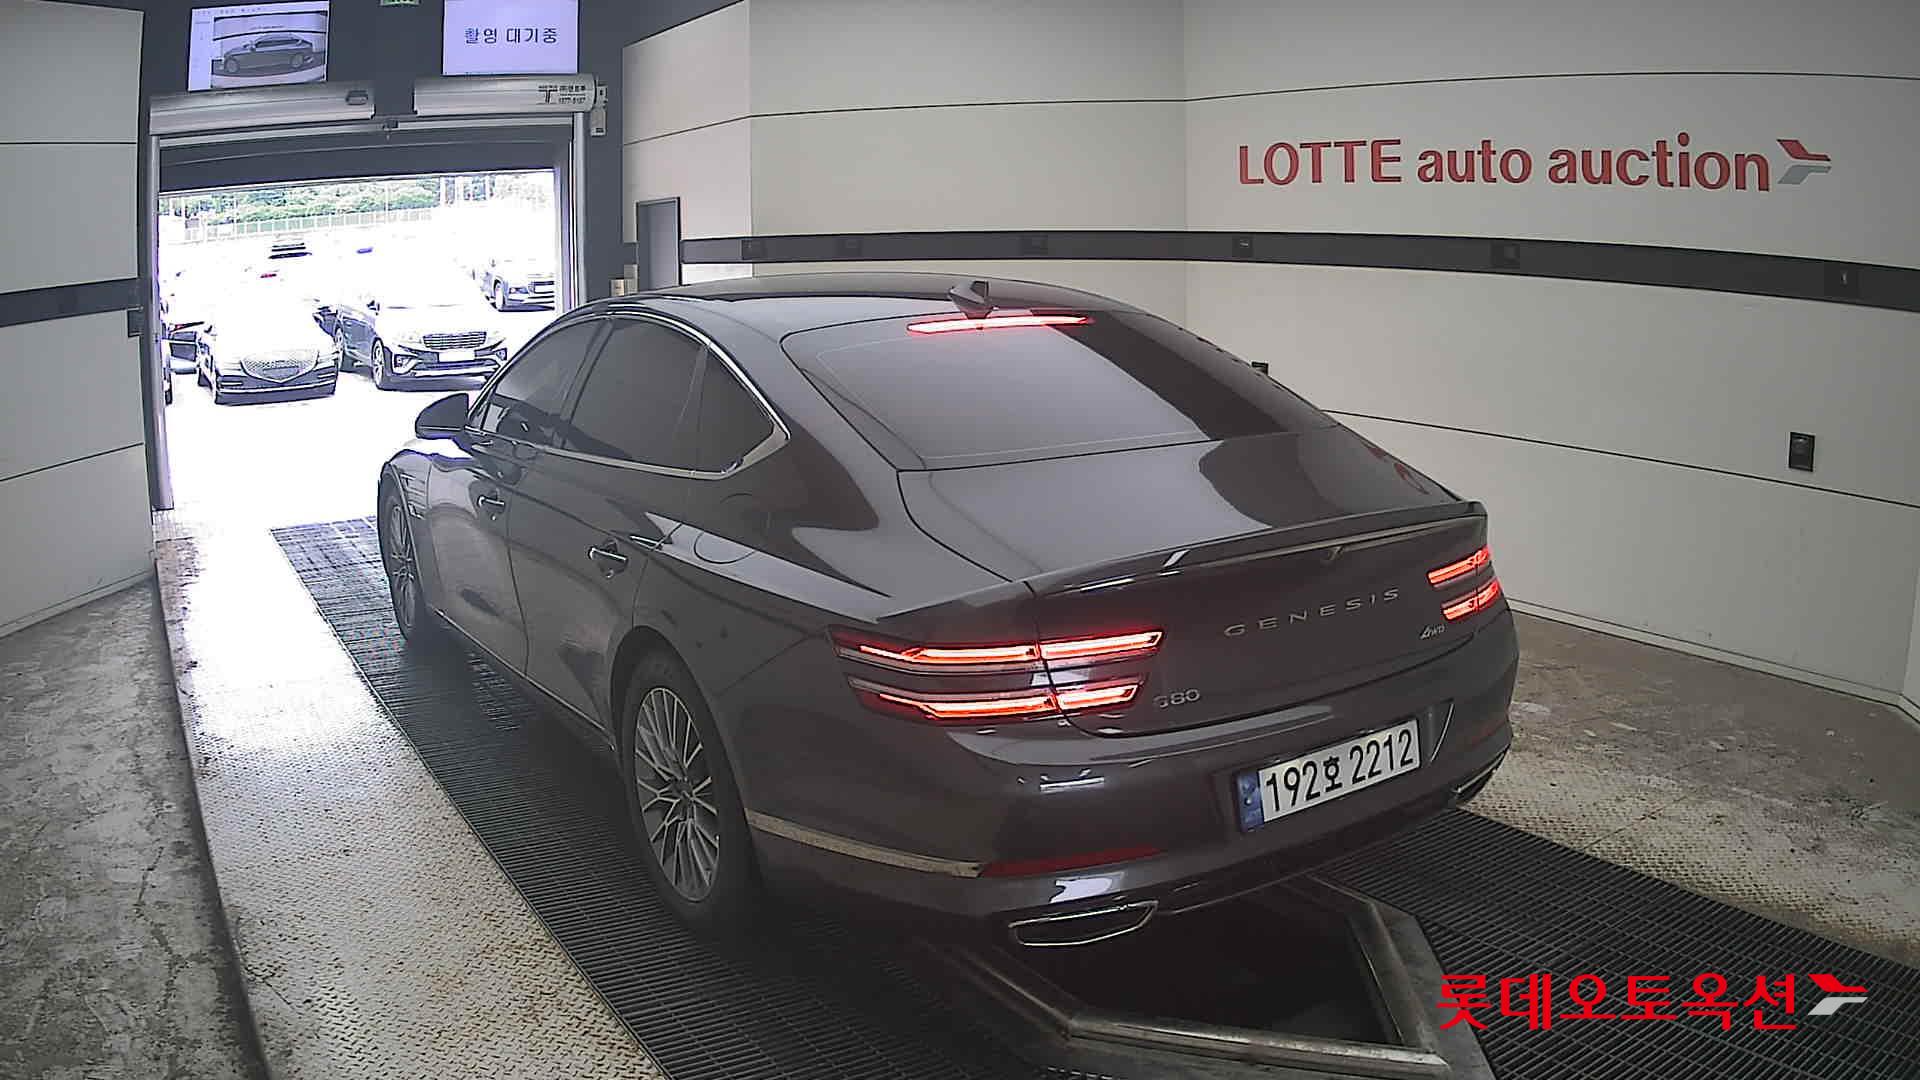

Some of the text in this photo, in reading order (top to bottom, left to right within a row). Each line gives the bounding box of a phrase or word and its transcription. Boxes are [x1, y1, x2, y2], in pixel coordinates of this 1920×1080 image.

[506, 27, 558, 44] 대기중
[1239, 132, 1770, 191] LOTTE auto auction
[1224, 588, 1399, 637] GENESIS
[1266, 729, 1413, 812] 192호 2212
